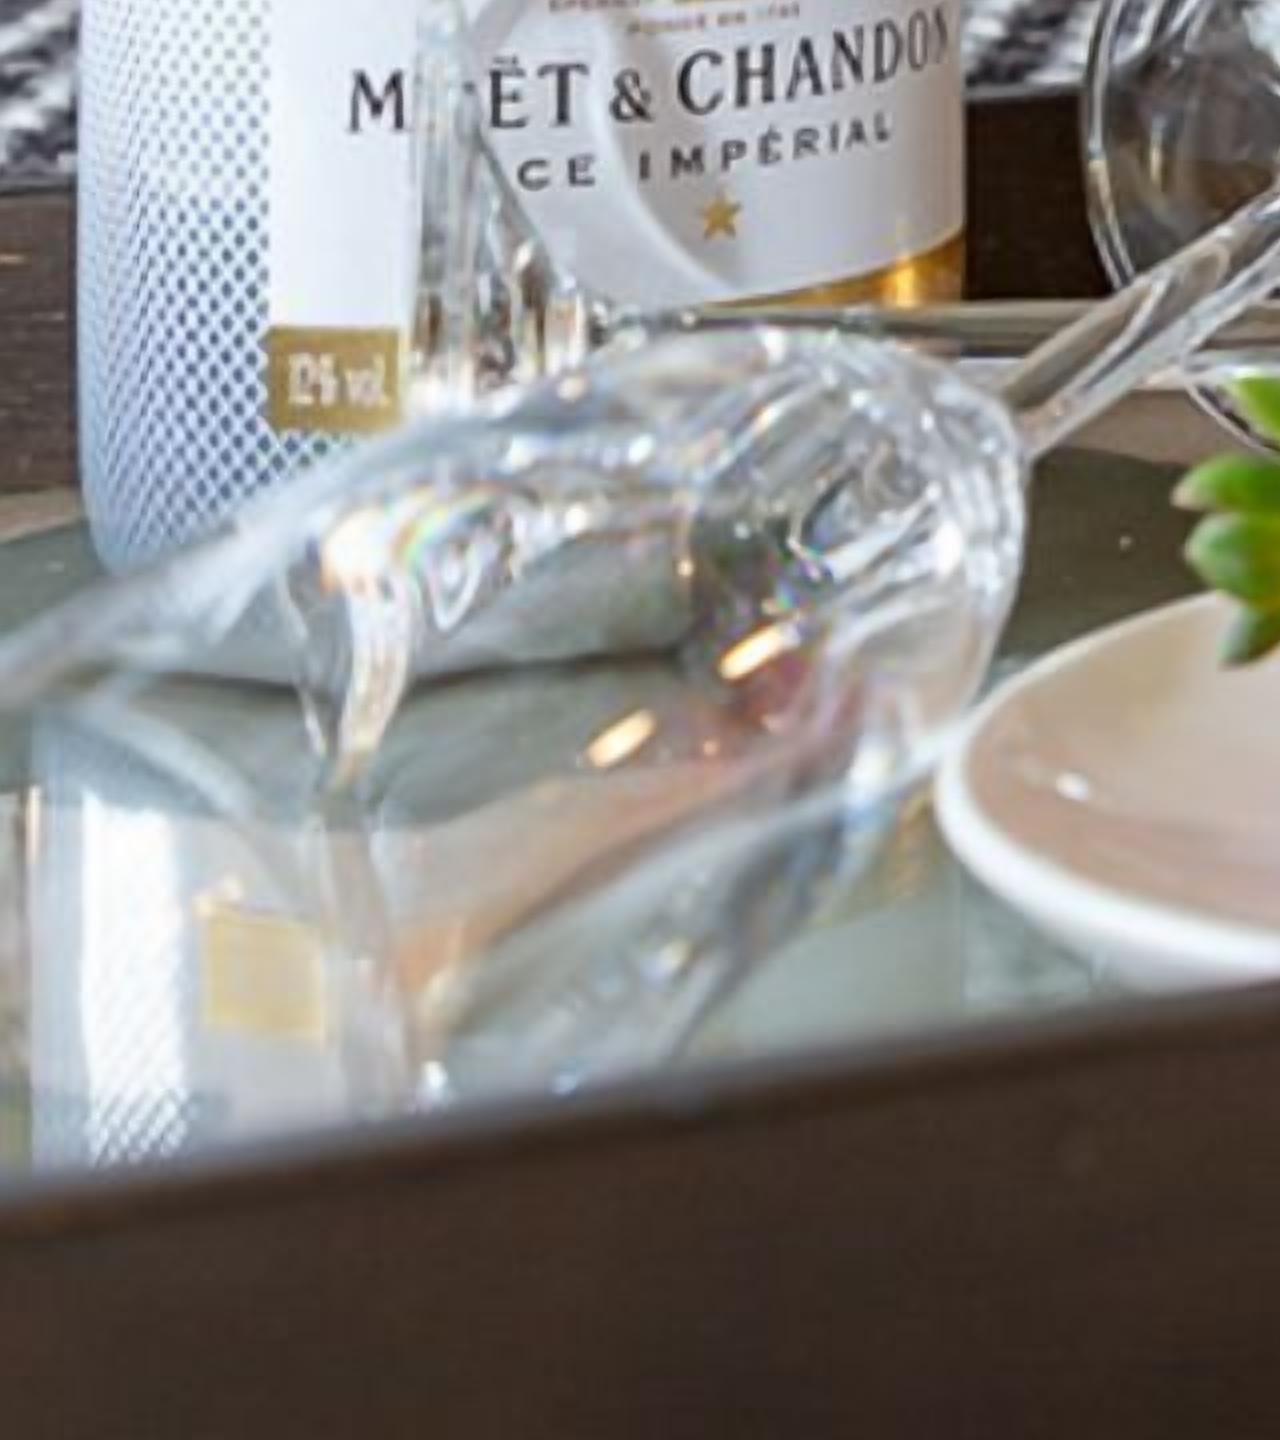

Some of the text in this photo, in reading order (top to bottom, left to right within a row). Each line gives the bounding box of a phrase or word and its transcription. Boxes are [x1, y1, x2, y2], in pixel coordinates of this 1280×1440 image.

[345, 53, 590, 134] MËT
[609, 67, 654, 123] &
[517, 110, 892, 192] CE IMPÉRIAL
